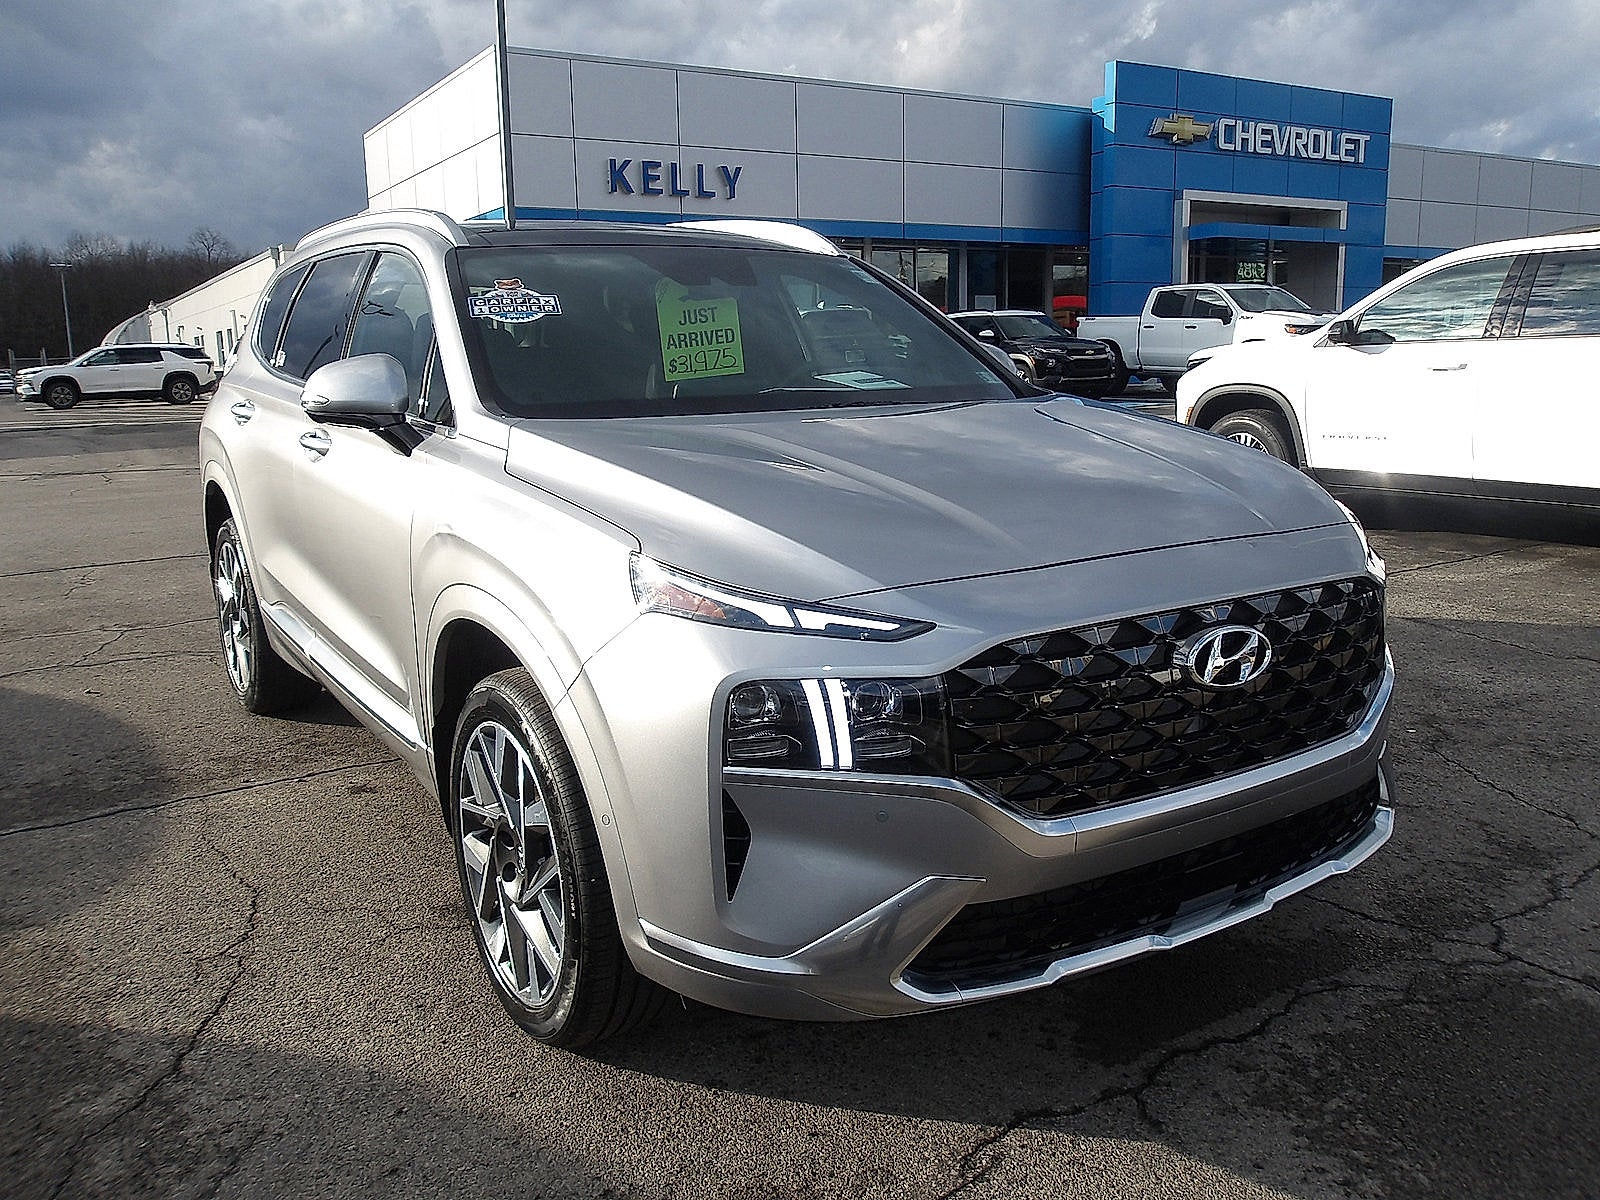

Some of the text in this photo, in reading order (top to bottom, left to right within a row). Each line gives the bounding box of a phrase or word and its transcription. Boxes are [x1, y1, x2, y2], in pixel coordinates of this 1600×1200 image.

[1217, 117, 1371, 164] CHEVROLET
[607, 156, 744, 200] KELLY
[475, 298, 553, 306] CARFAX
[490, 305, 555, 313] OWNER
[678, 306, 718, 326] JUST
[666, 328, 736, 350] ARRIVED
[668, 347, 739, 375] $31,975
